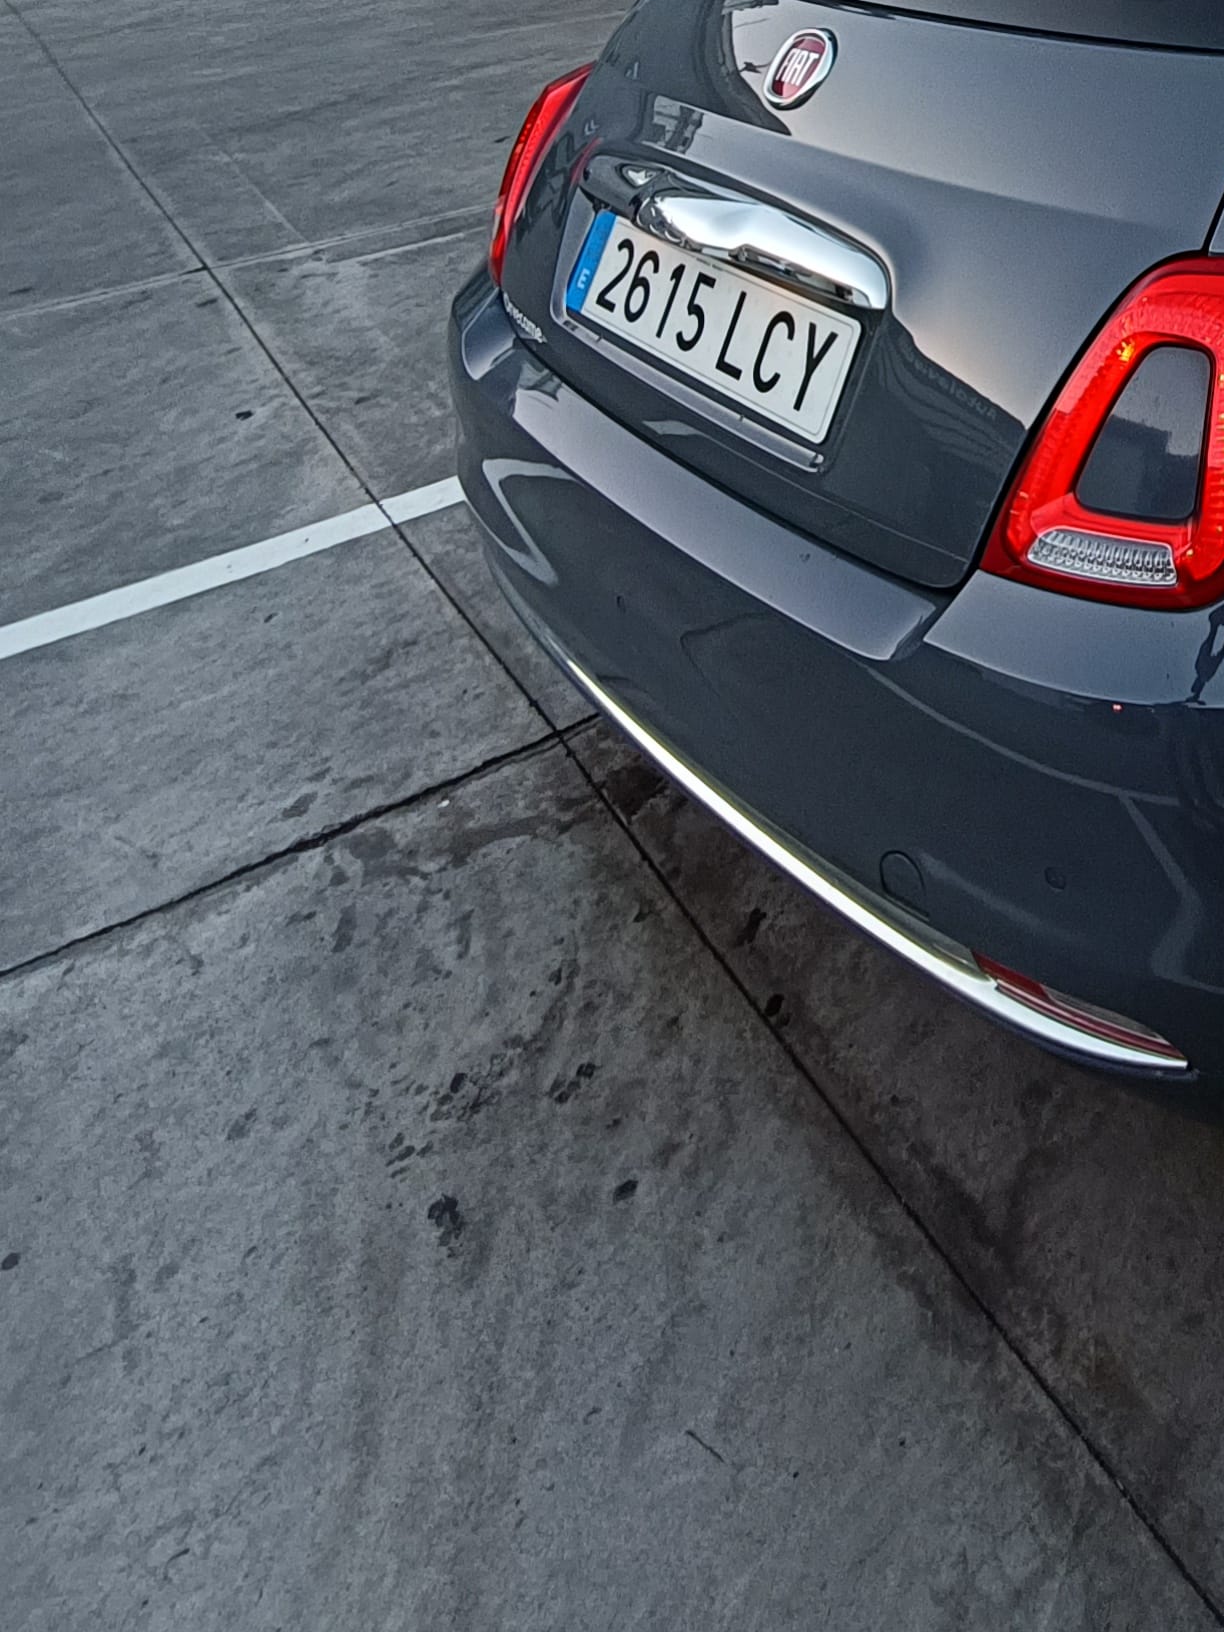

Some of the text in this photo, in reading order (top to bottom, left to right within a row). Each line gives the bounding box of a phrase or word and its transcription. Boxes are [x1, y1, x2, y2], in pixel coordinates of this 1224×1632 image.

[774, 47, 820, 87] FIAT
[595, 239, 838, 412] 2615 LCY
